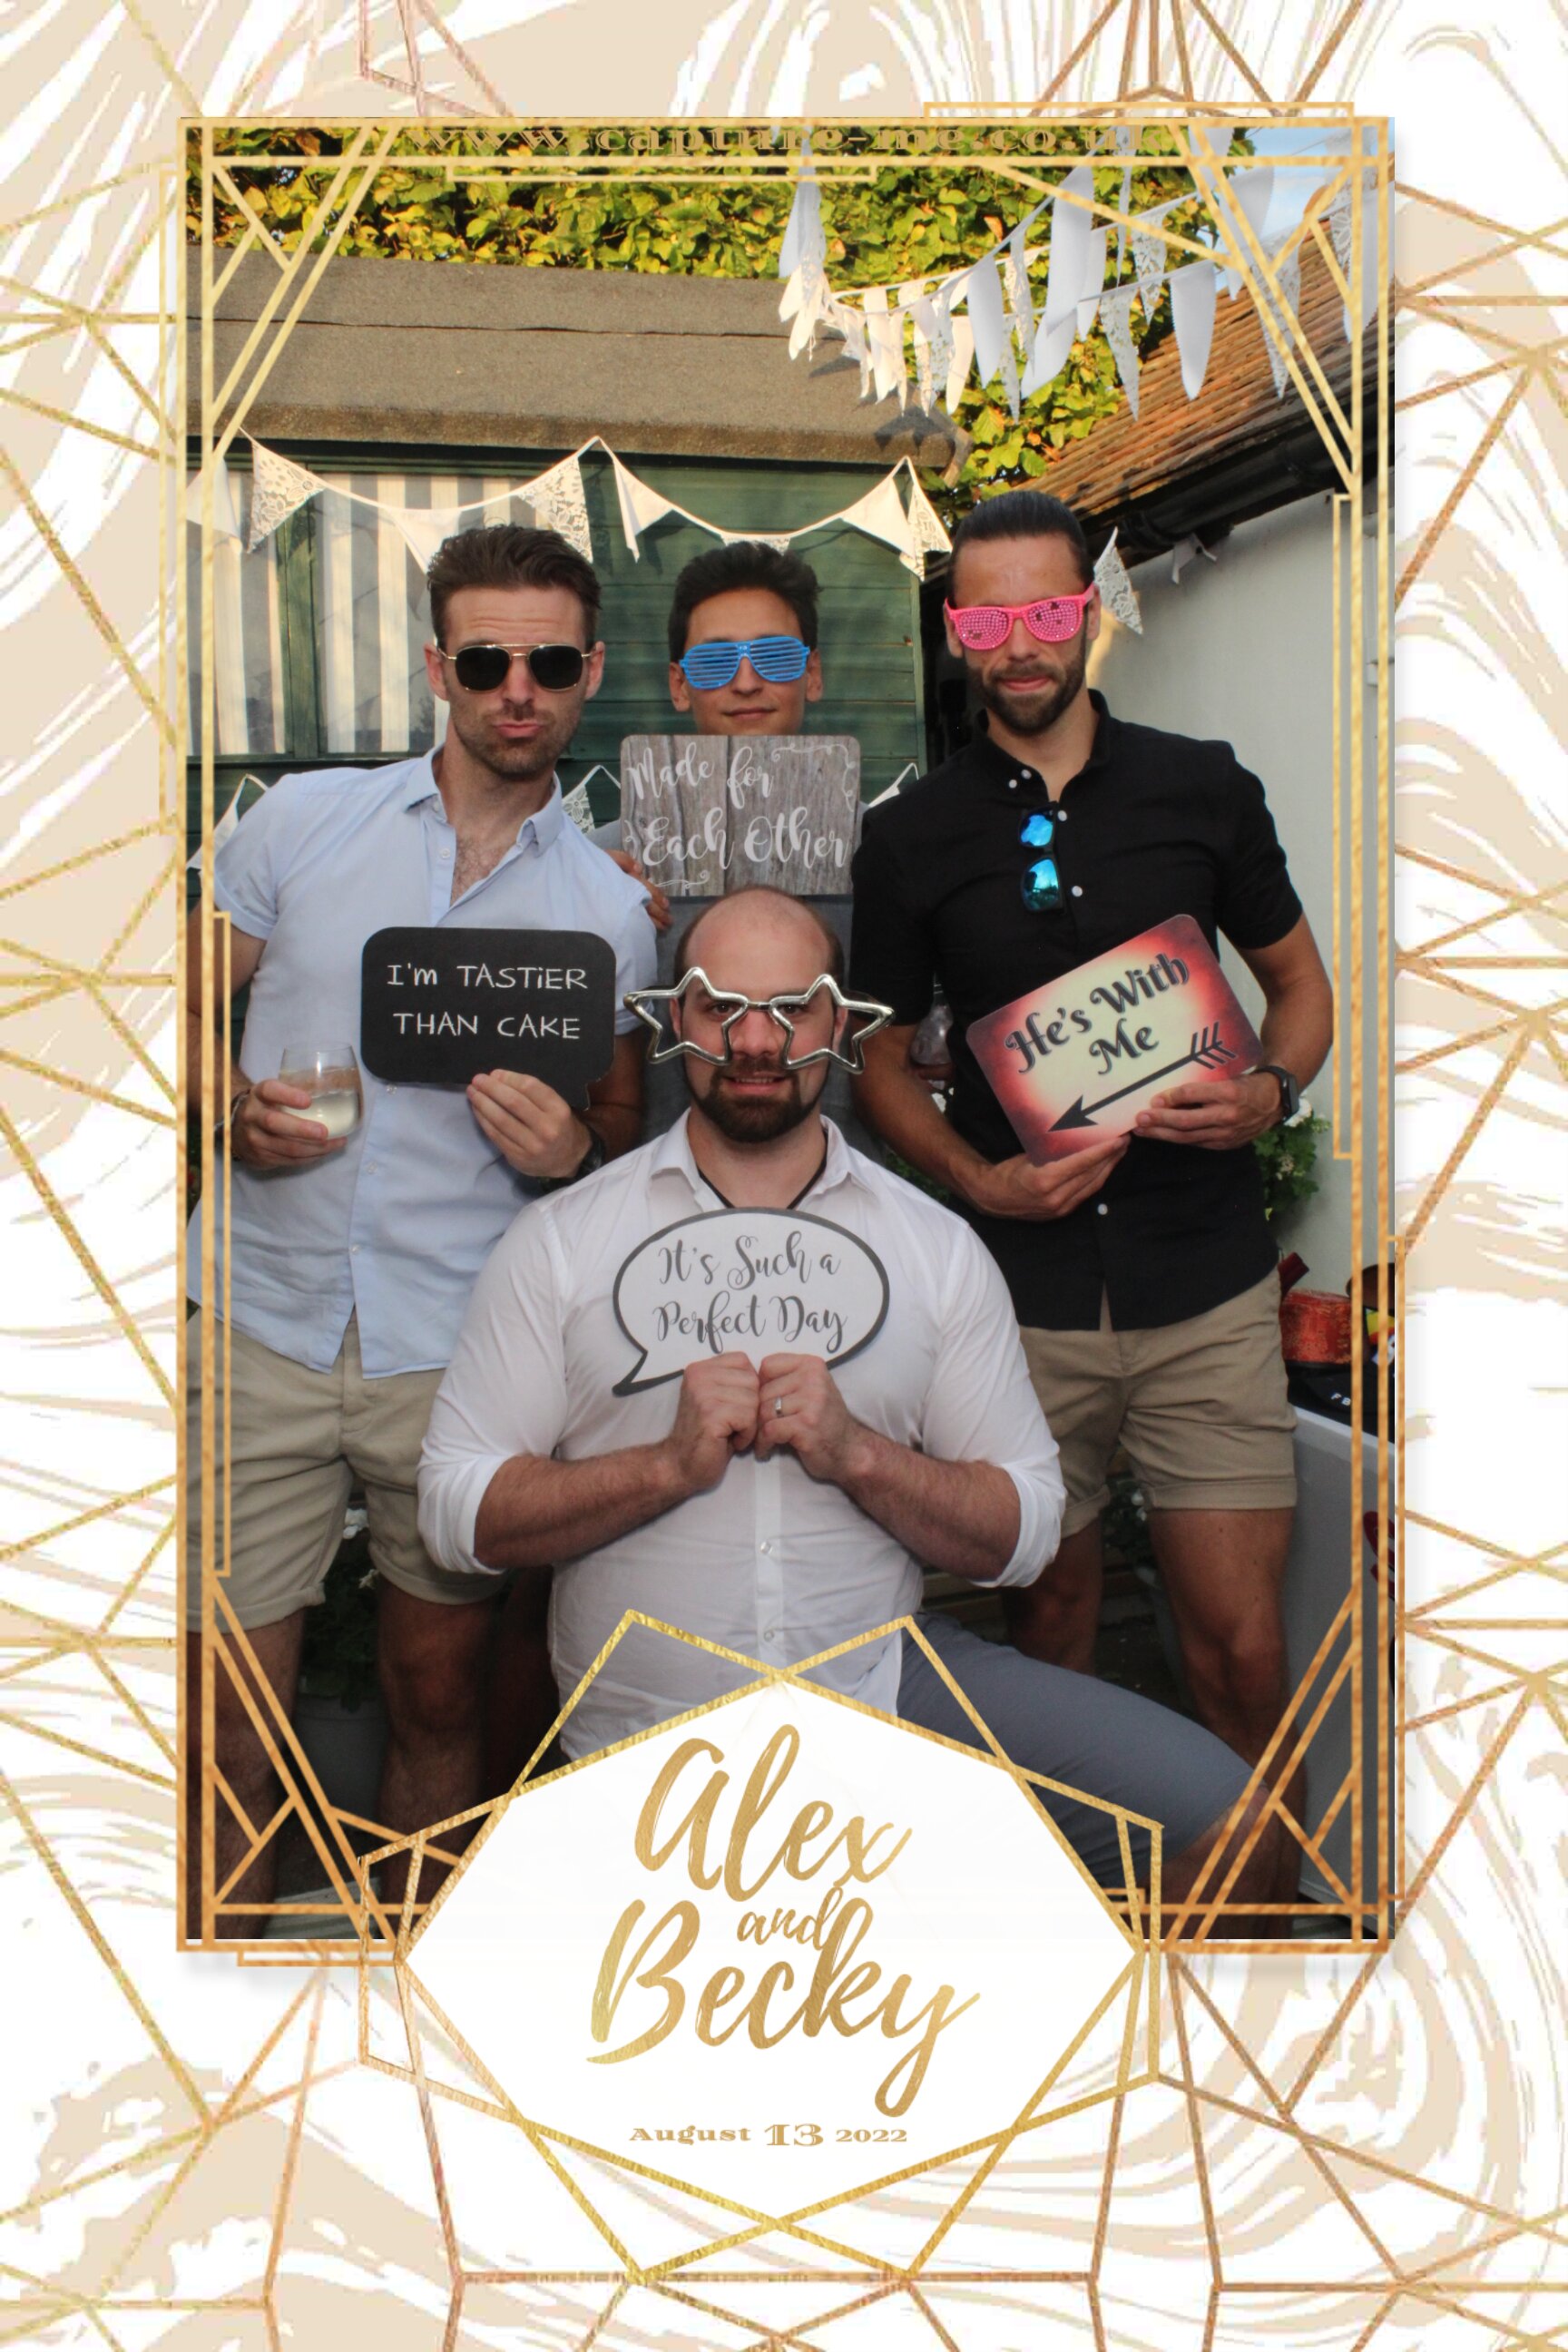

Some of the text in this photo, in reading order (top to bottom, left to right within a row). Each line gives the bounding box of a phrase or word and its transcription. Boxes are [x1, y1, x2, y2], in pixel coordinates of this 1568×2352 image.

[626, 742, 774, 809] Made for
[642, 806, 849, 869] Each Other
[387, 963, 438, 986] I'm
[393, 1012, 581, 1040] THAN CAKE
[1004, 953, 1190, 1074] He's With
[1089, 1017, 1160, 1075] Me
[658, 1230, 841, 1290] It's Such a
[652, 1290, 848, 1355] Perfect Day
